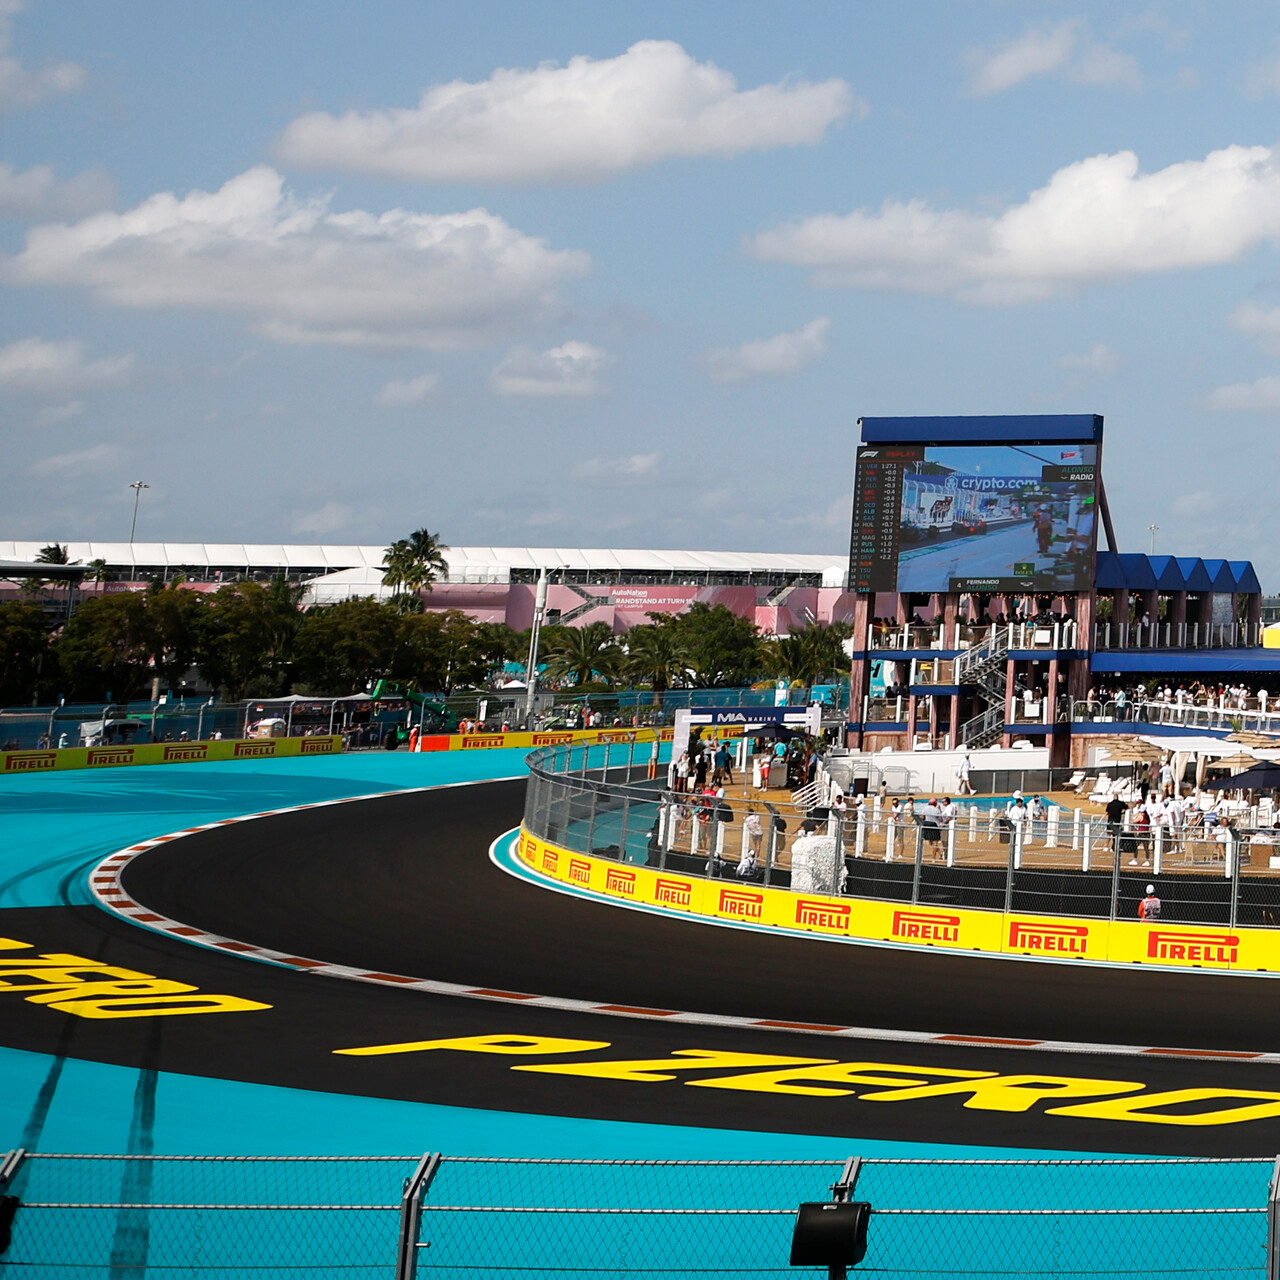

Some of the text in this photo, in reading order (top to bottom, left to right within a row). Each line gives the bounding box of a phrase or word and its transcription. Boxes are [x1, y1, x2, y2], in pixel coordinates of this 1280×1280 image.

[961, 478, 1037, 491] crypto.com
[612, 589, 648, 597] AutoNation
[779, 681, 785, 689] 9
[717, 712, 747, 722] MIA
[301, 738, 333, 752] PIRELLI
[463, 736, 504, 748] PIRELLI
[533, 733, 573, 745] PIRELLI
[164, 745, 208, 760] PIRELLI
[234, 741, 275, 756] PIRELLI
[6, 753, 57, 770] PIRELLI
[87, 749, 135, 765] PIRELLI
[606, 869, 636, 895] PIRELLI
[655, 878, 692, 906] PIRELLI
[719, 889, 764, 918] PIRELLI
[796, 900, 851, 930] PIRELLI
[893, 912, 961, 942] PIRELLI
[1010, 921, 1088, 954] PIRELLI
[1148, 932, 1240, 964] PIRELLI
[332, 1034, 611, 1056] P
